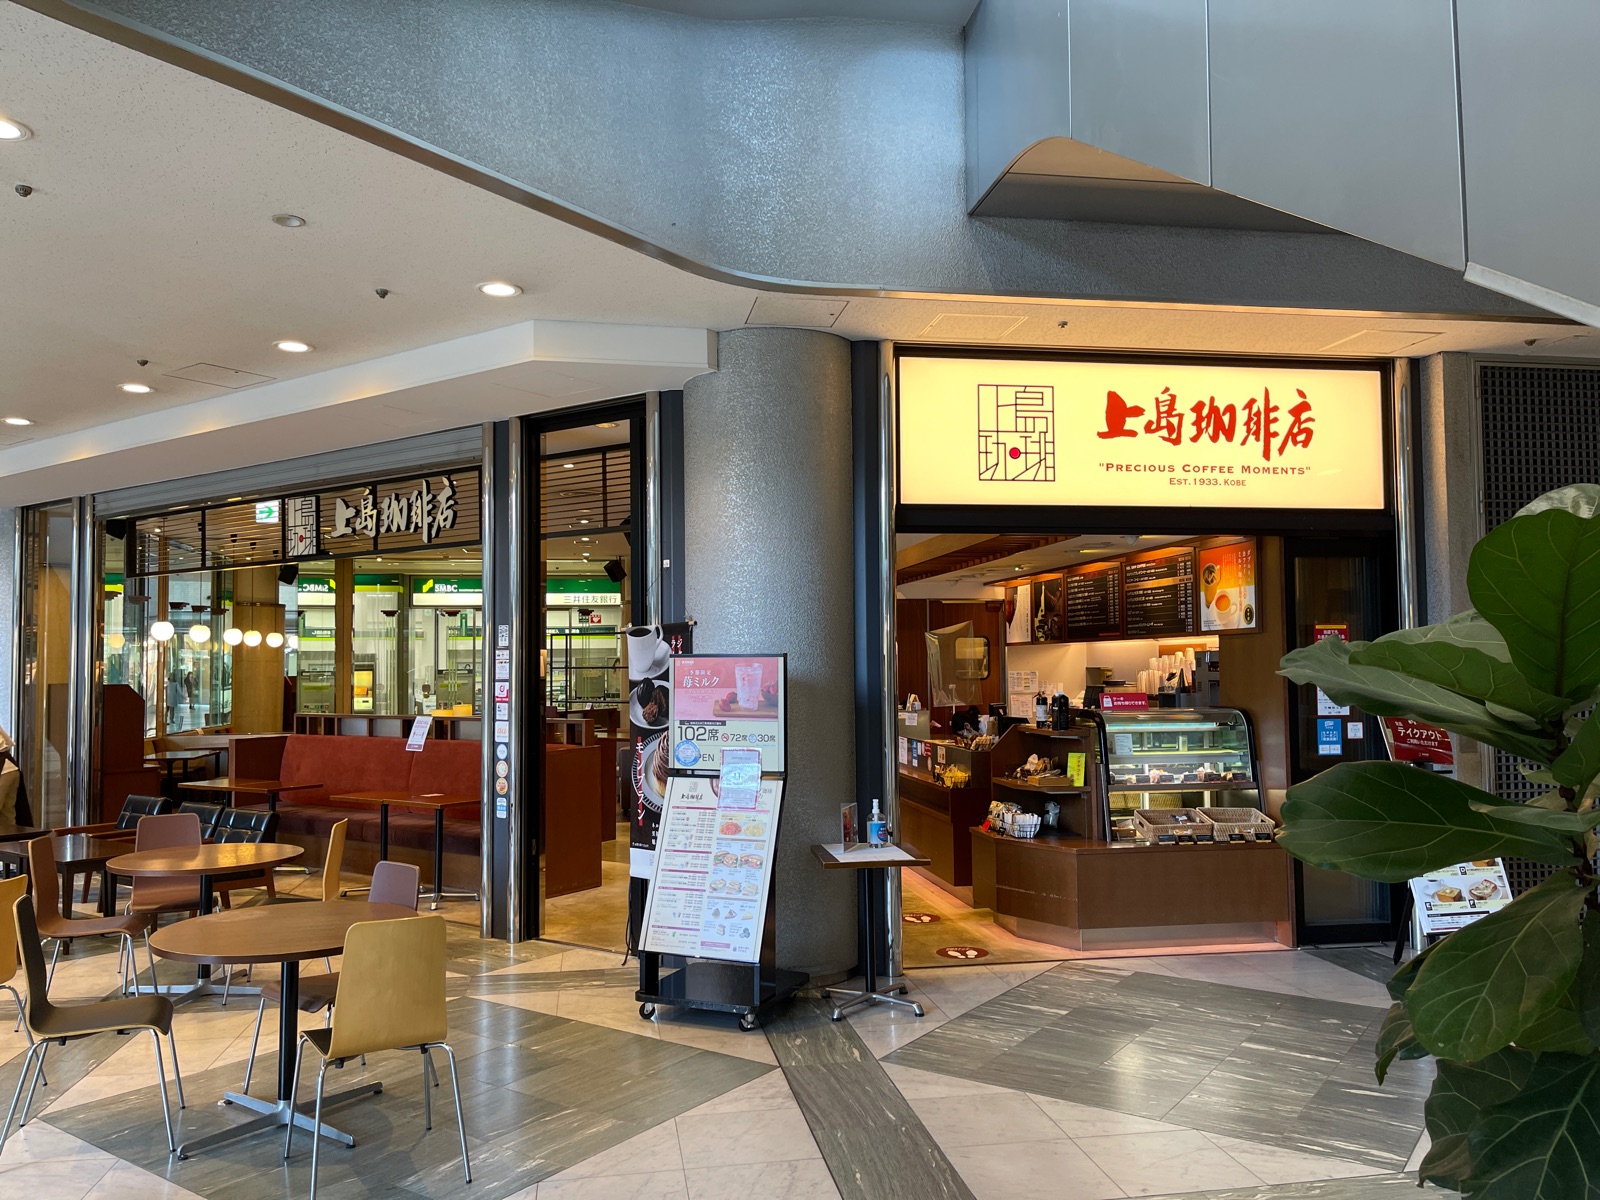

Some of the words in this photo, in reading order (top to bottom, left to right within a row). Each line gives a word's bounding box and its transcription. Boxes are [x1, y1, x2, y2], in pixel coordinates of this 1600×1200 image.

[1096, 386, 1316, 462] 上島珈琲店
[1181, 464, 1235, 475] COFFEE
[331, 476, 458, 544] 上島珈琲店
[434, 583, 458, 592] SMBC
[563, 595, 618, 604] 三井住友銀行
[683, 675, 720, 688] 苺ミルク
[677, 726, 719, 741] 102席
[1397, 726, 1442, 740] テイクアウト
[698, 753, 715, 762] PEN
[636, 741, 646, 820] モンブラン
